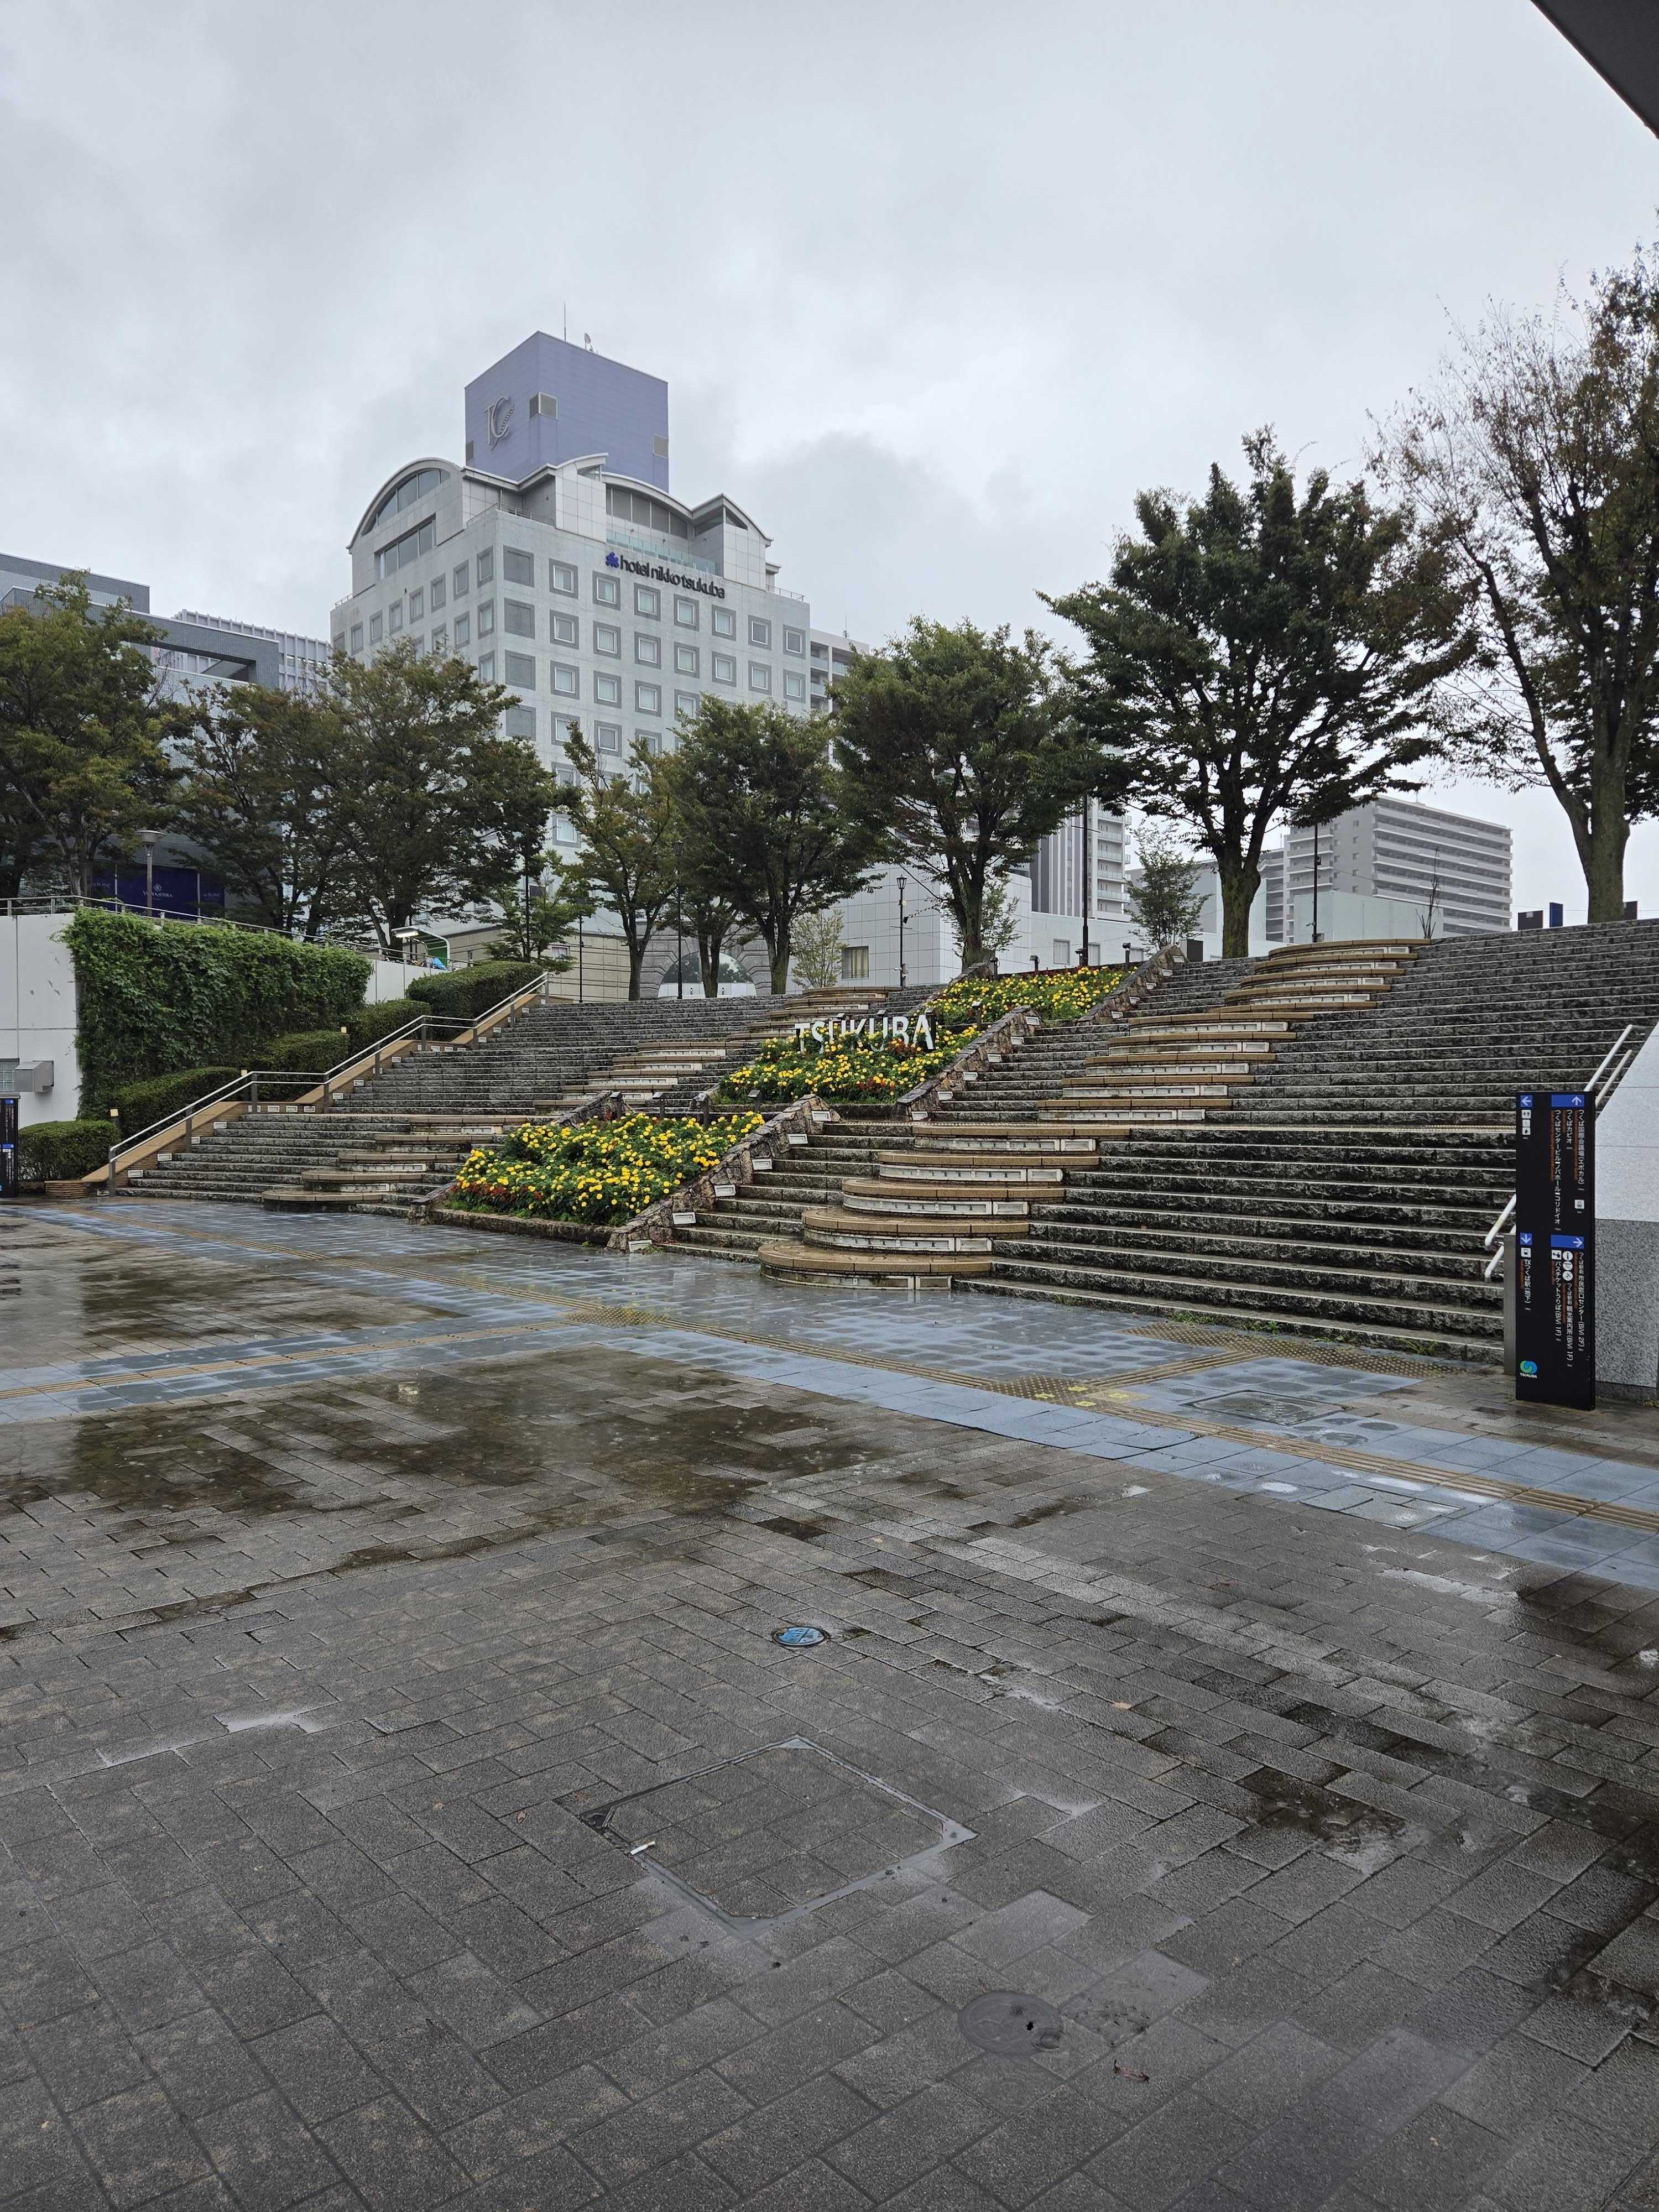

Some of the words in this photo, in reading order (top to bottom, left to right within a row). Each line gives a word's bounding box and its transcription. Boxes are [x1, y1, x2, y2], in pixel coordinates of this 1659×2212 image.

[620, 555, 649, 577] hotel
[651, 566, 681, 586] nikko
[681, 573, 725, 599] tsukuba
